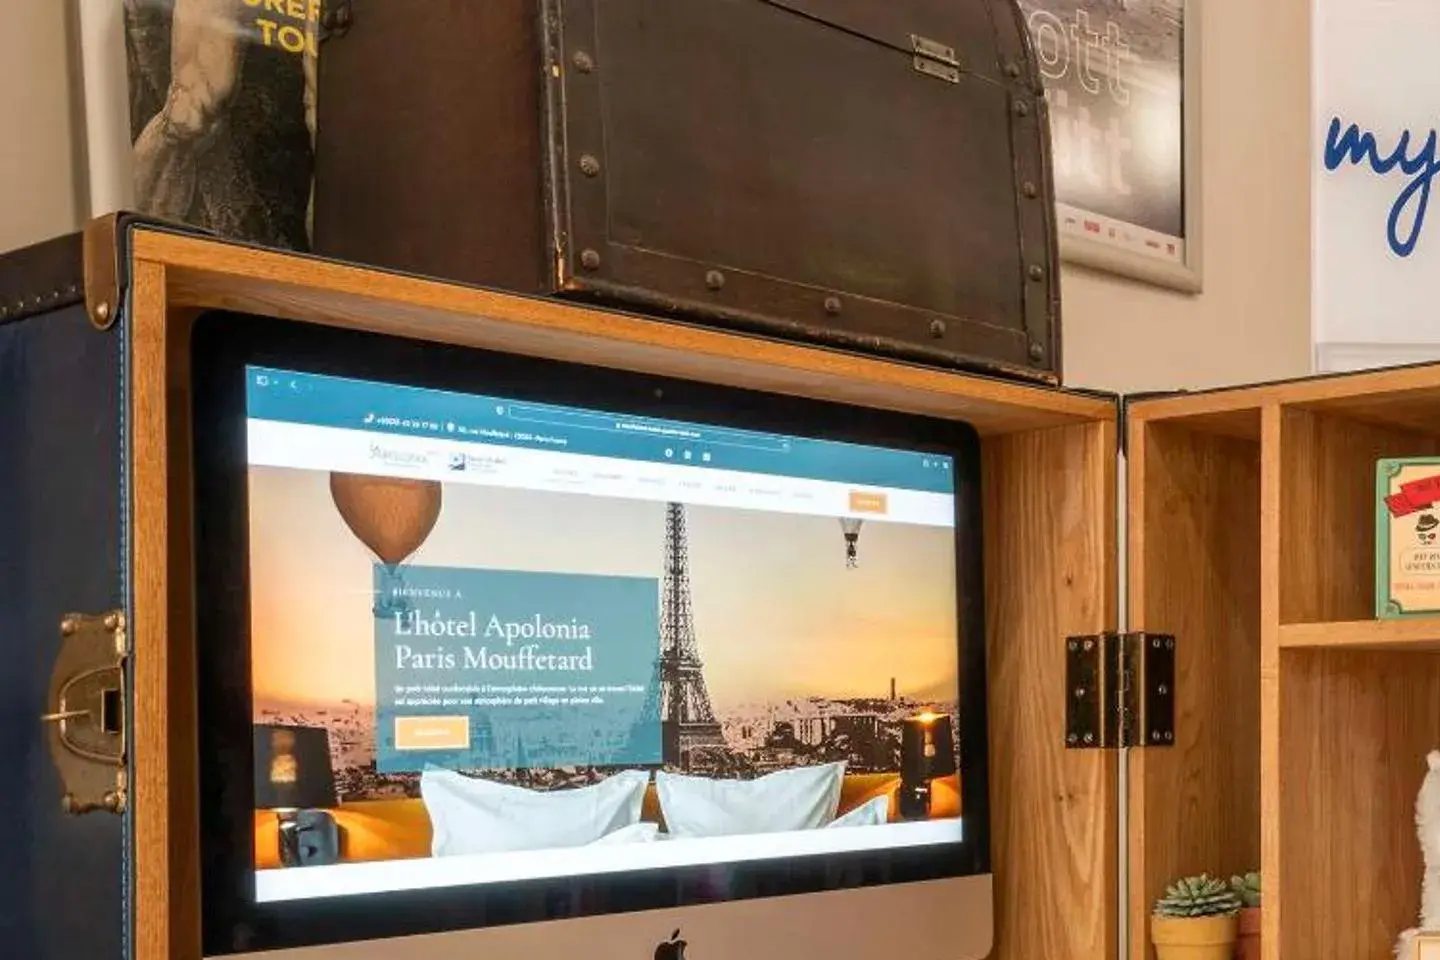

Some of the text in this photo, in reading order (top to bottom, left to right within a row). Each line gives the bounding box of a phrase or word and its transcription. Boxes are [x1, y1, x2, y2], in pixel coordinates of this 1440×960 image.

[483, 613, 591, 647] Apolonia
[395, 643, 594, 672] Paris Mouffetard
